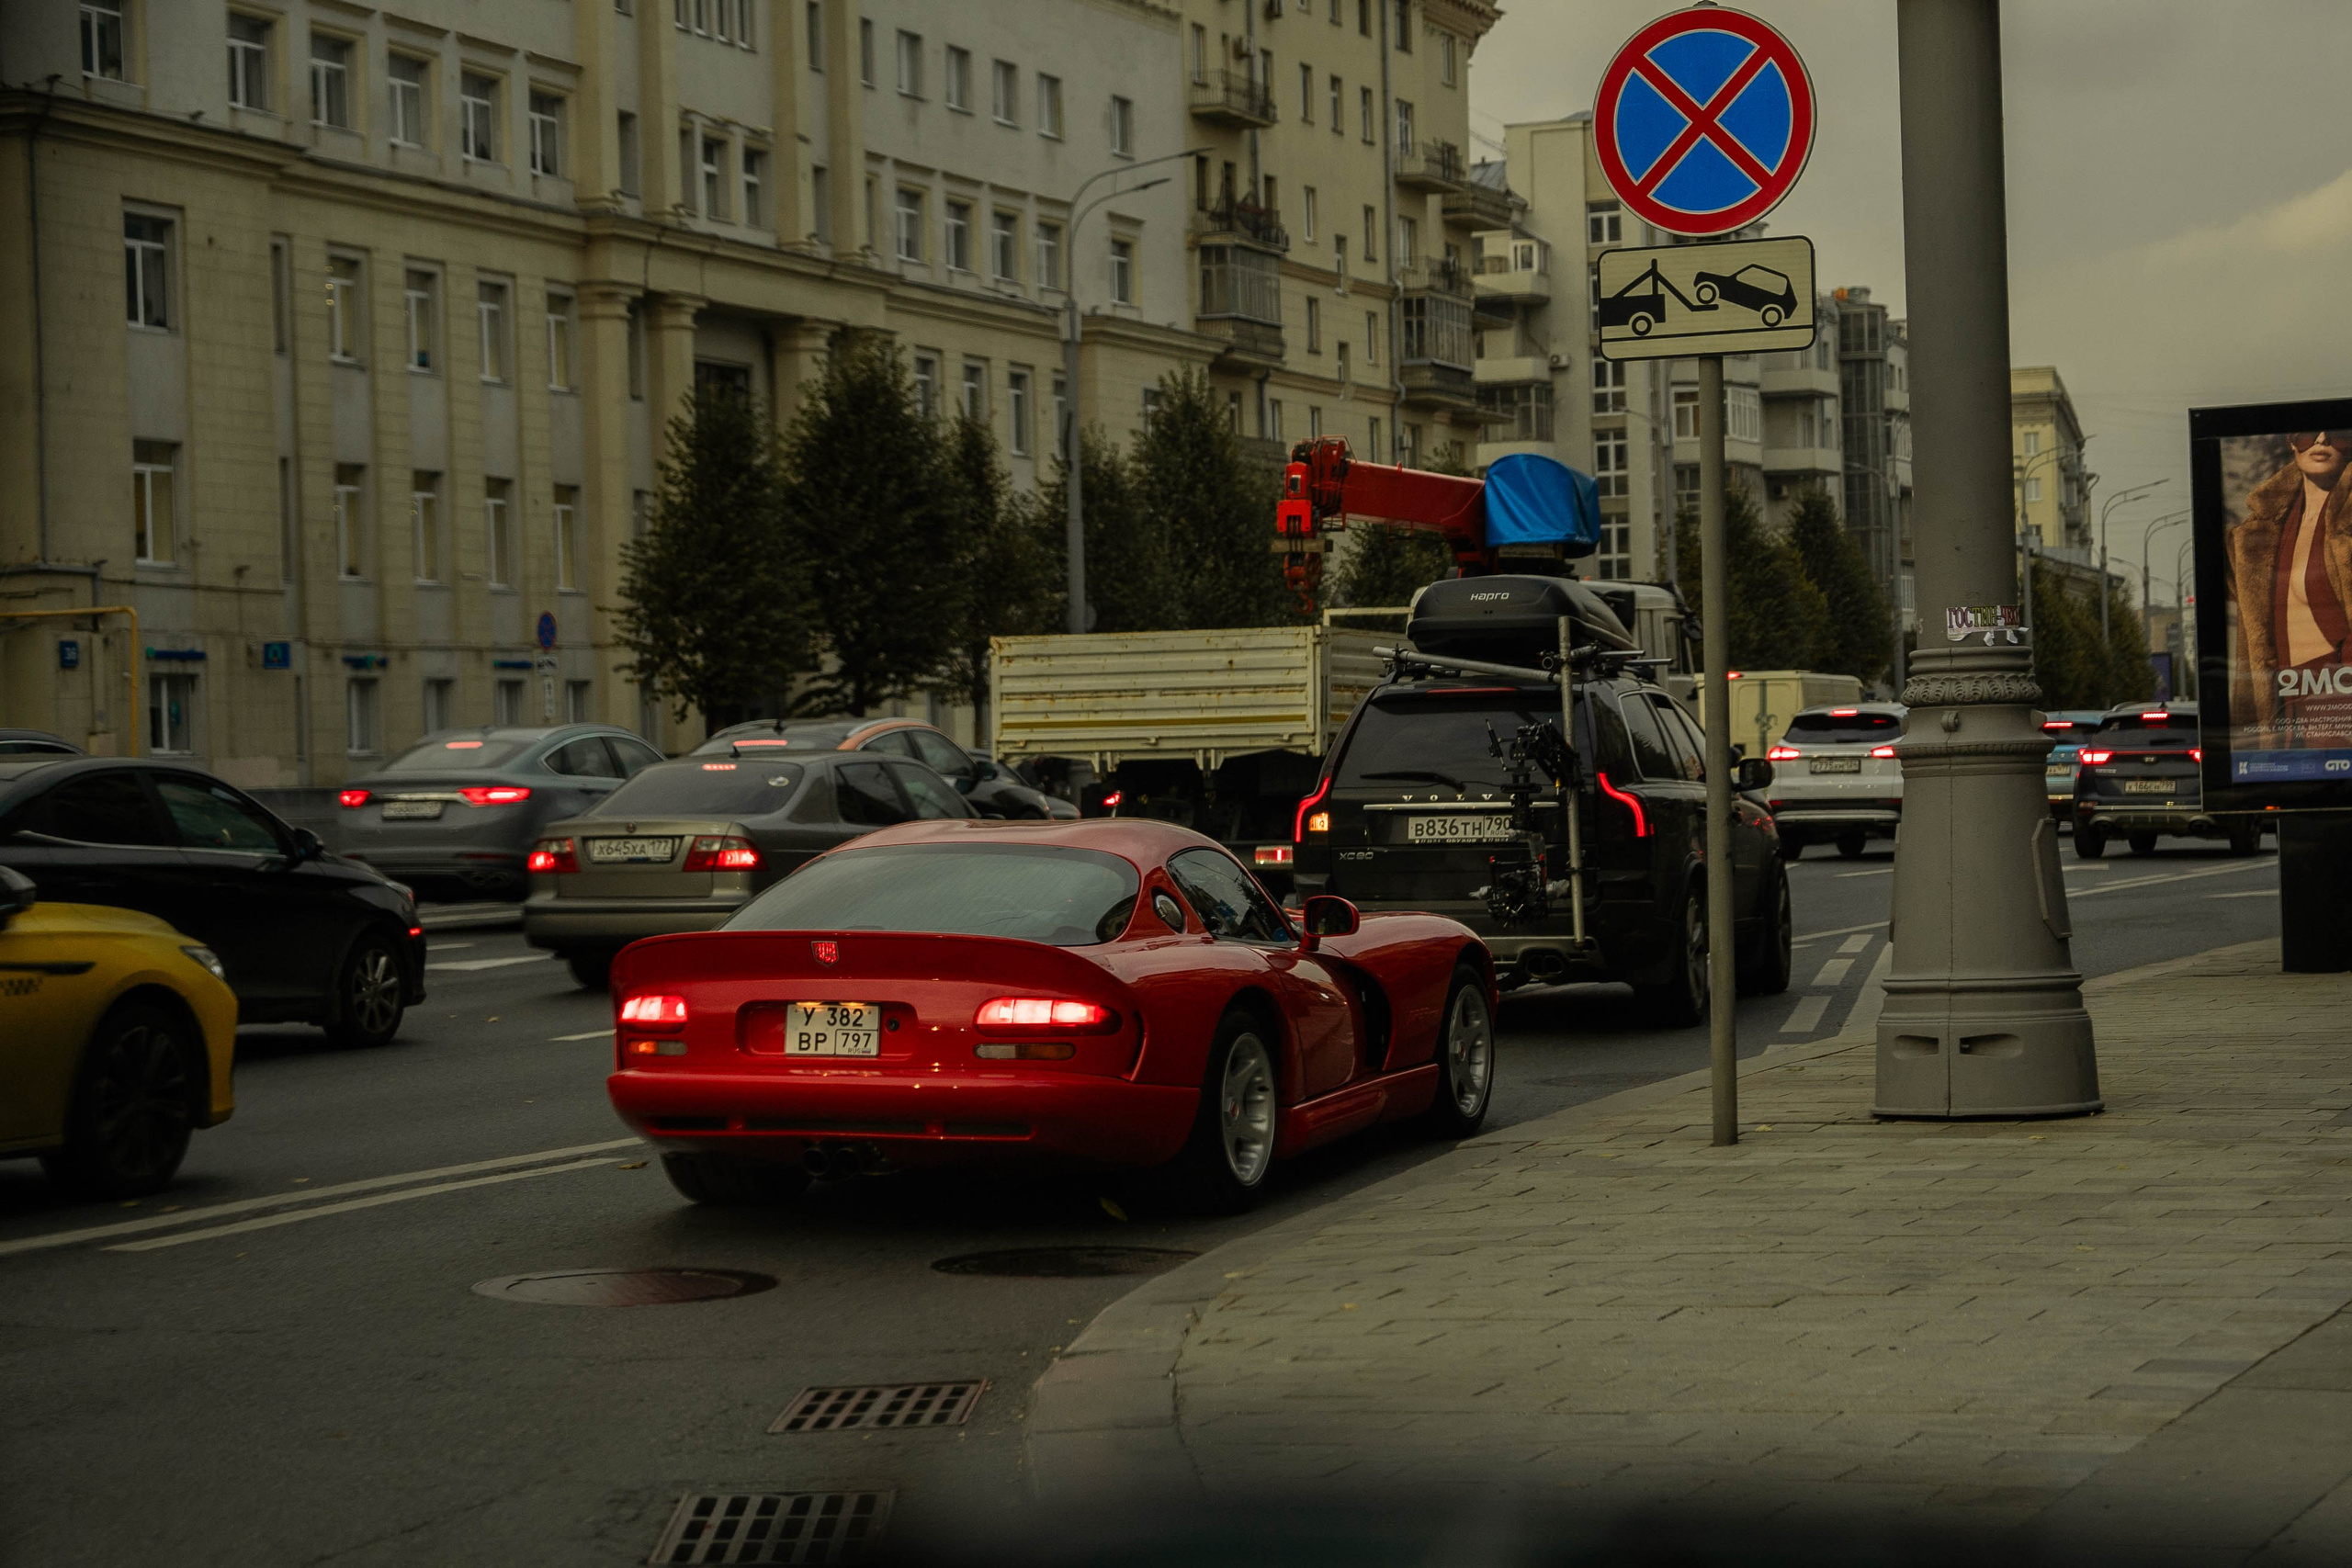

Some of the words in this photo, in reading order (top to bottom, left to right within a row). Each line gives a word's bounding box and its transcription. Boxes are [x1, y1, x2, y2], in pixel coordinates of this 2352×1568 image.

[1415, 818, 1482, 837] В836ТН
[1339, 851, 1374, 861] XC90
[803, 1007, 816, 1026] У
[827, 1007, 864, 1027] 382
[798, 1032, 827, 1051] ВР
[841, 1032, 872, 1048] 797
